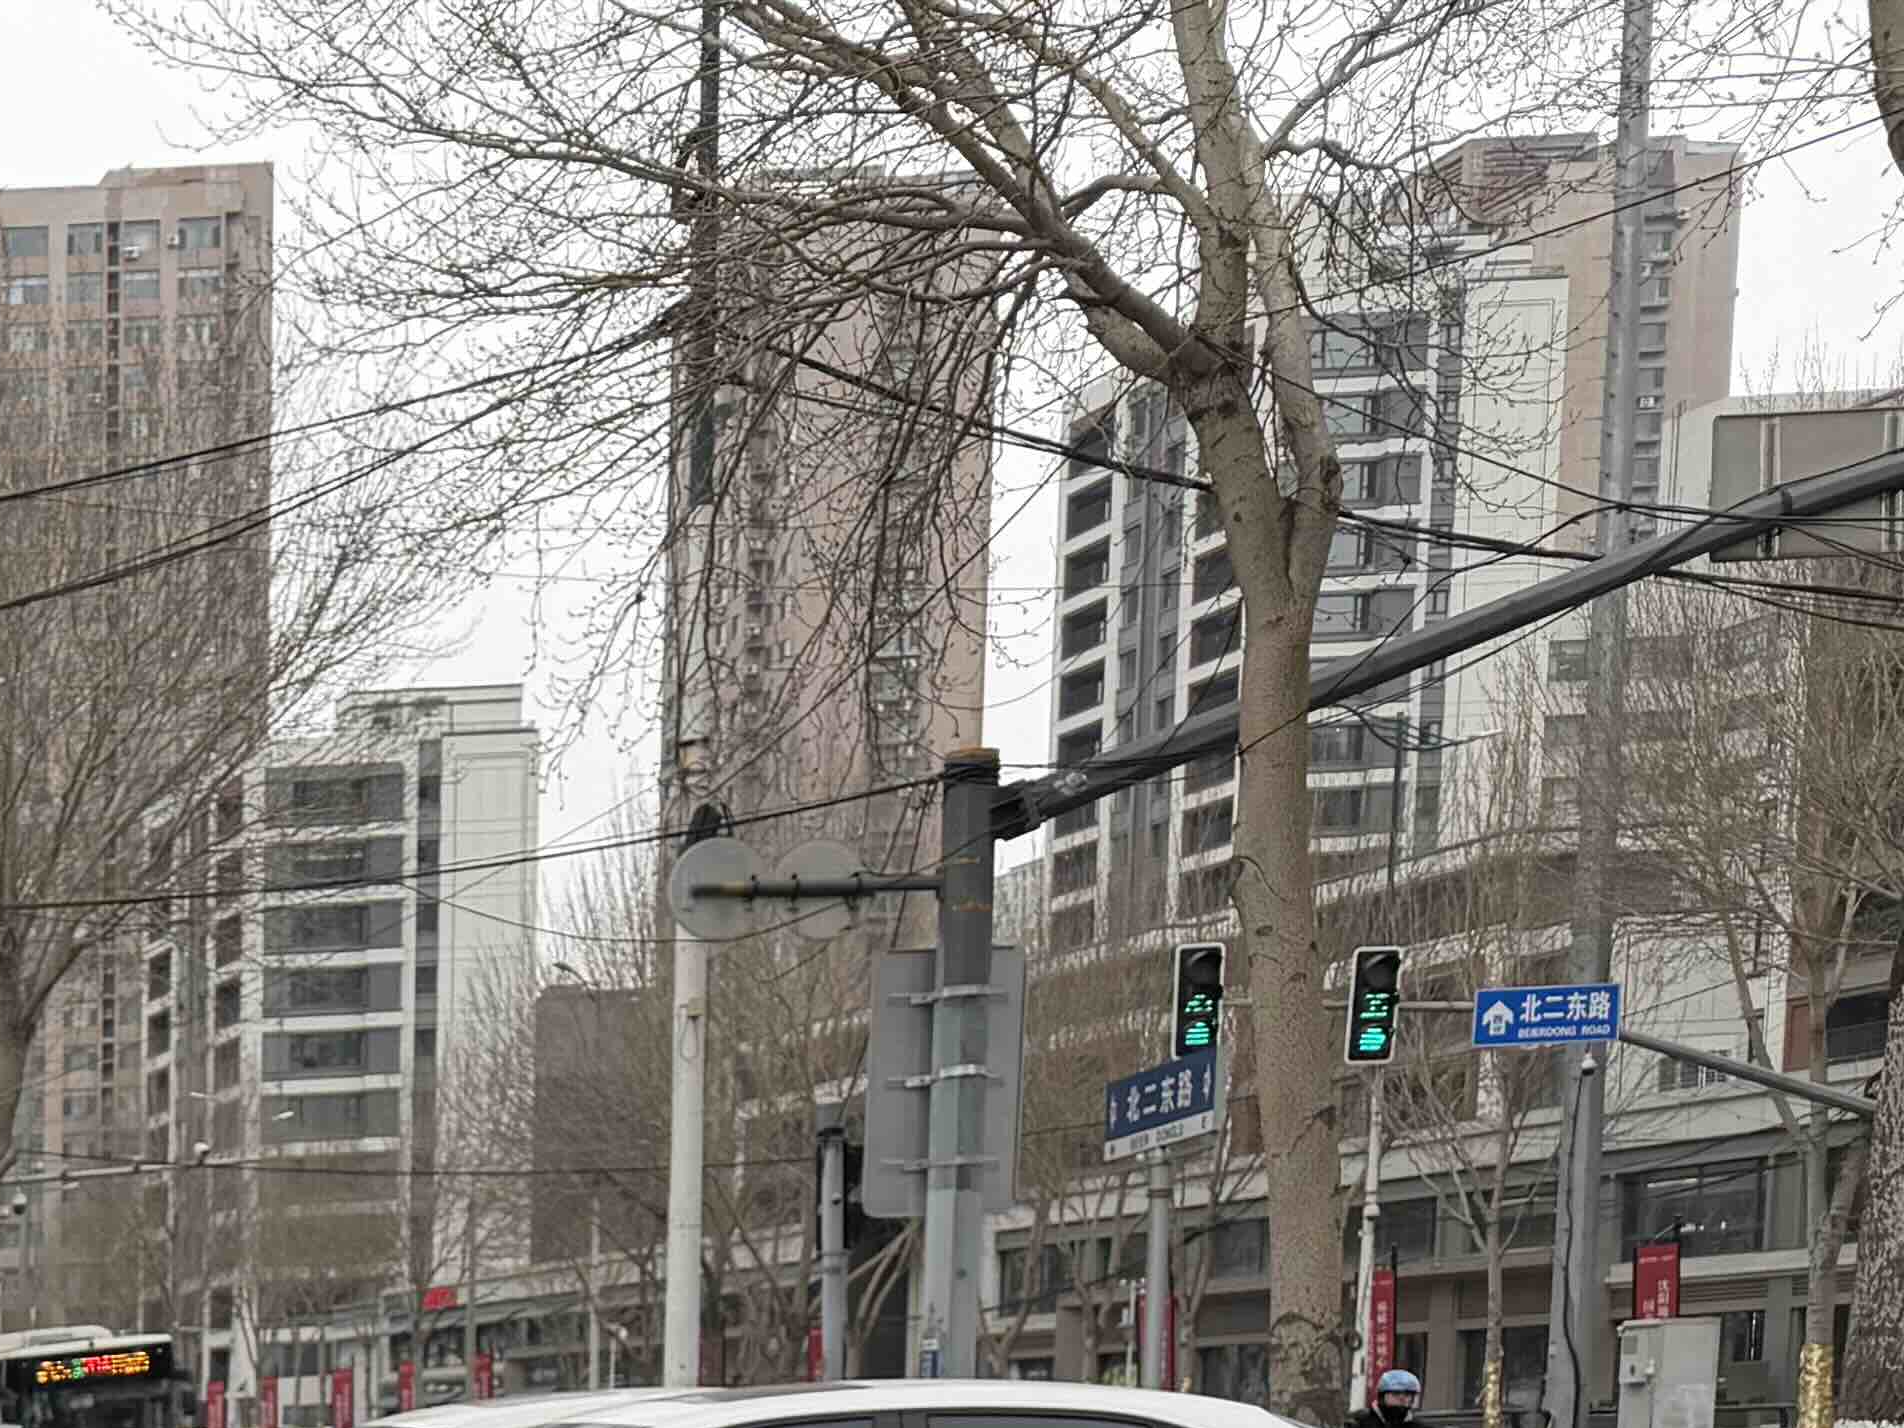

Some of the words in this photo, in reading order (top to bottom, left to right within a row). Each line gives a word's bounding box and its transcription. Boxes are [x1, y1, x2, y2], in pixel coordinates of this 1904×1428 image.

[1519, 990, 1611, 1024] 北二东路
[1126, 1068, 1193, 1124] 北二东路
